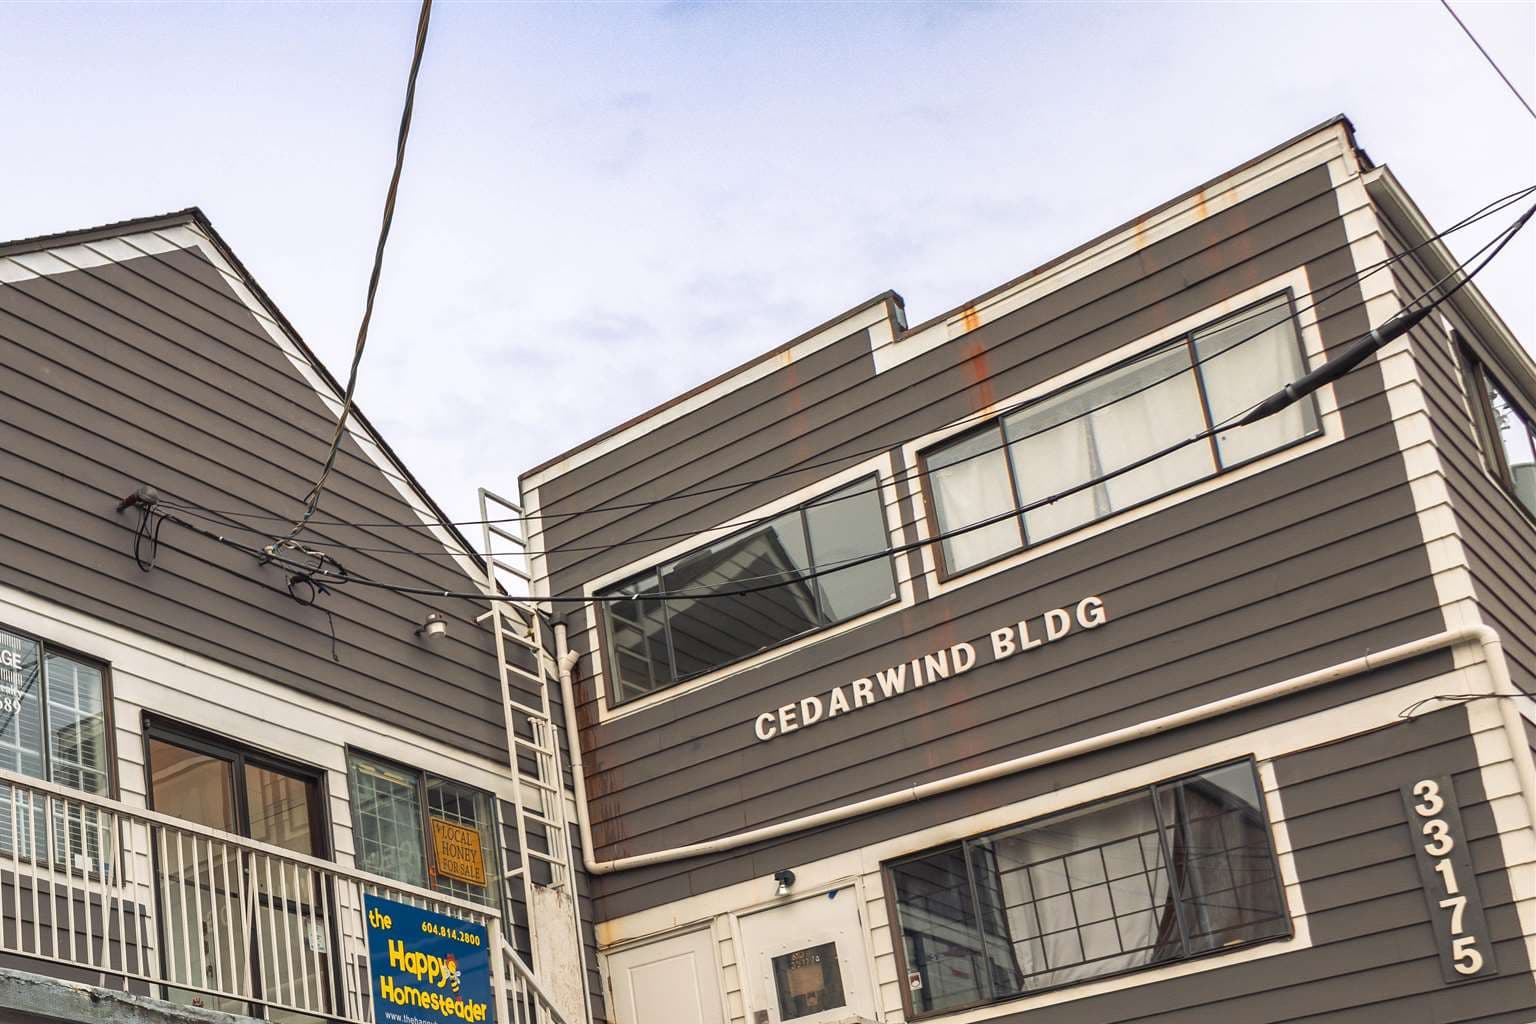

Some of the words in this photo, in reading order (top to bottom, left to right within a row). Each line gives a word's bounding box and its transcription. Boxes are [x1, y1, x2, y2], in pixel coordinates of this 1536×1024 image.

[754, 642, 977, 741] CEDARWIND
[990, 596, 1106, 660] BLDG
[442, 825, 473, 846] LOCAL
[442, 841, 477, 863] HONEY
[442, 857, 459, 873] FOR
[459, 863, 481, 880] SALE
[1412, 779, 1483, 975] 33175
[369, 907, 392, 930] the
[421, 921, 481, 946] 604.814.2800
[388, 939, 448, 988] Happy
[380, 975, 487, 1023] Homesteader
